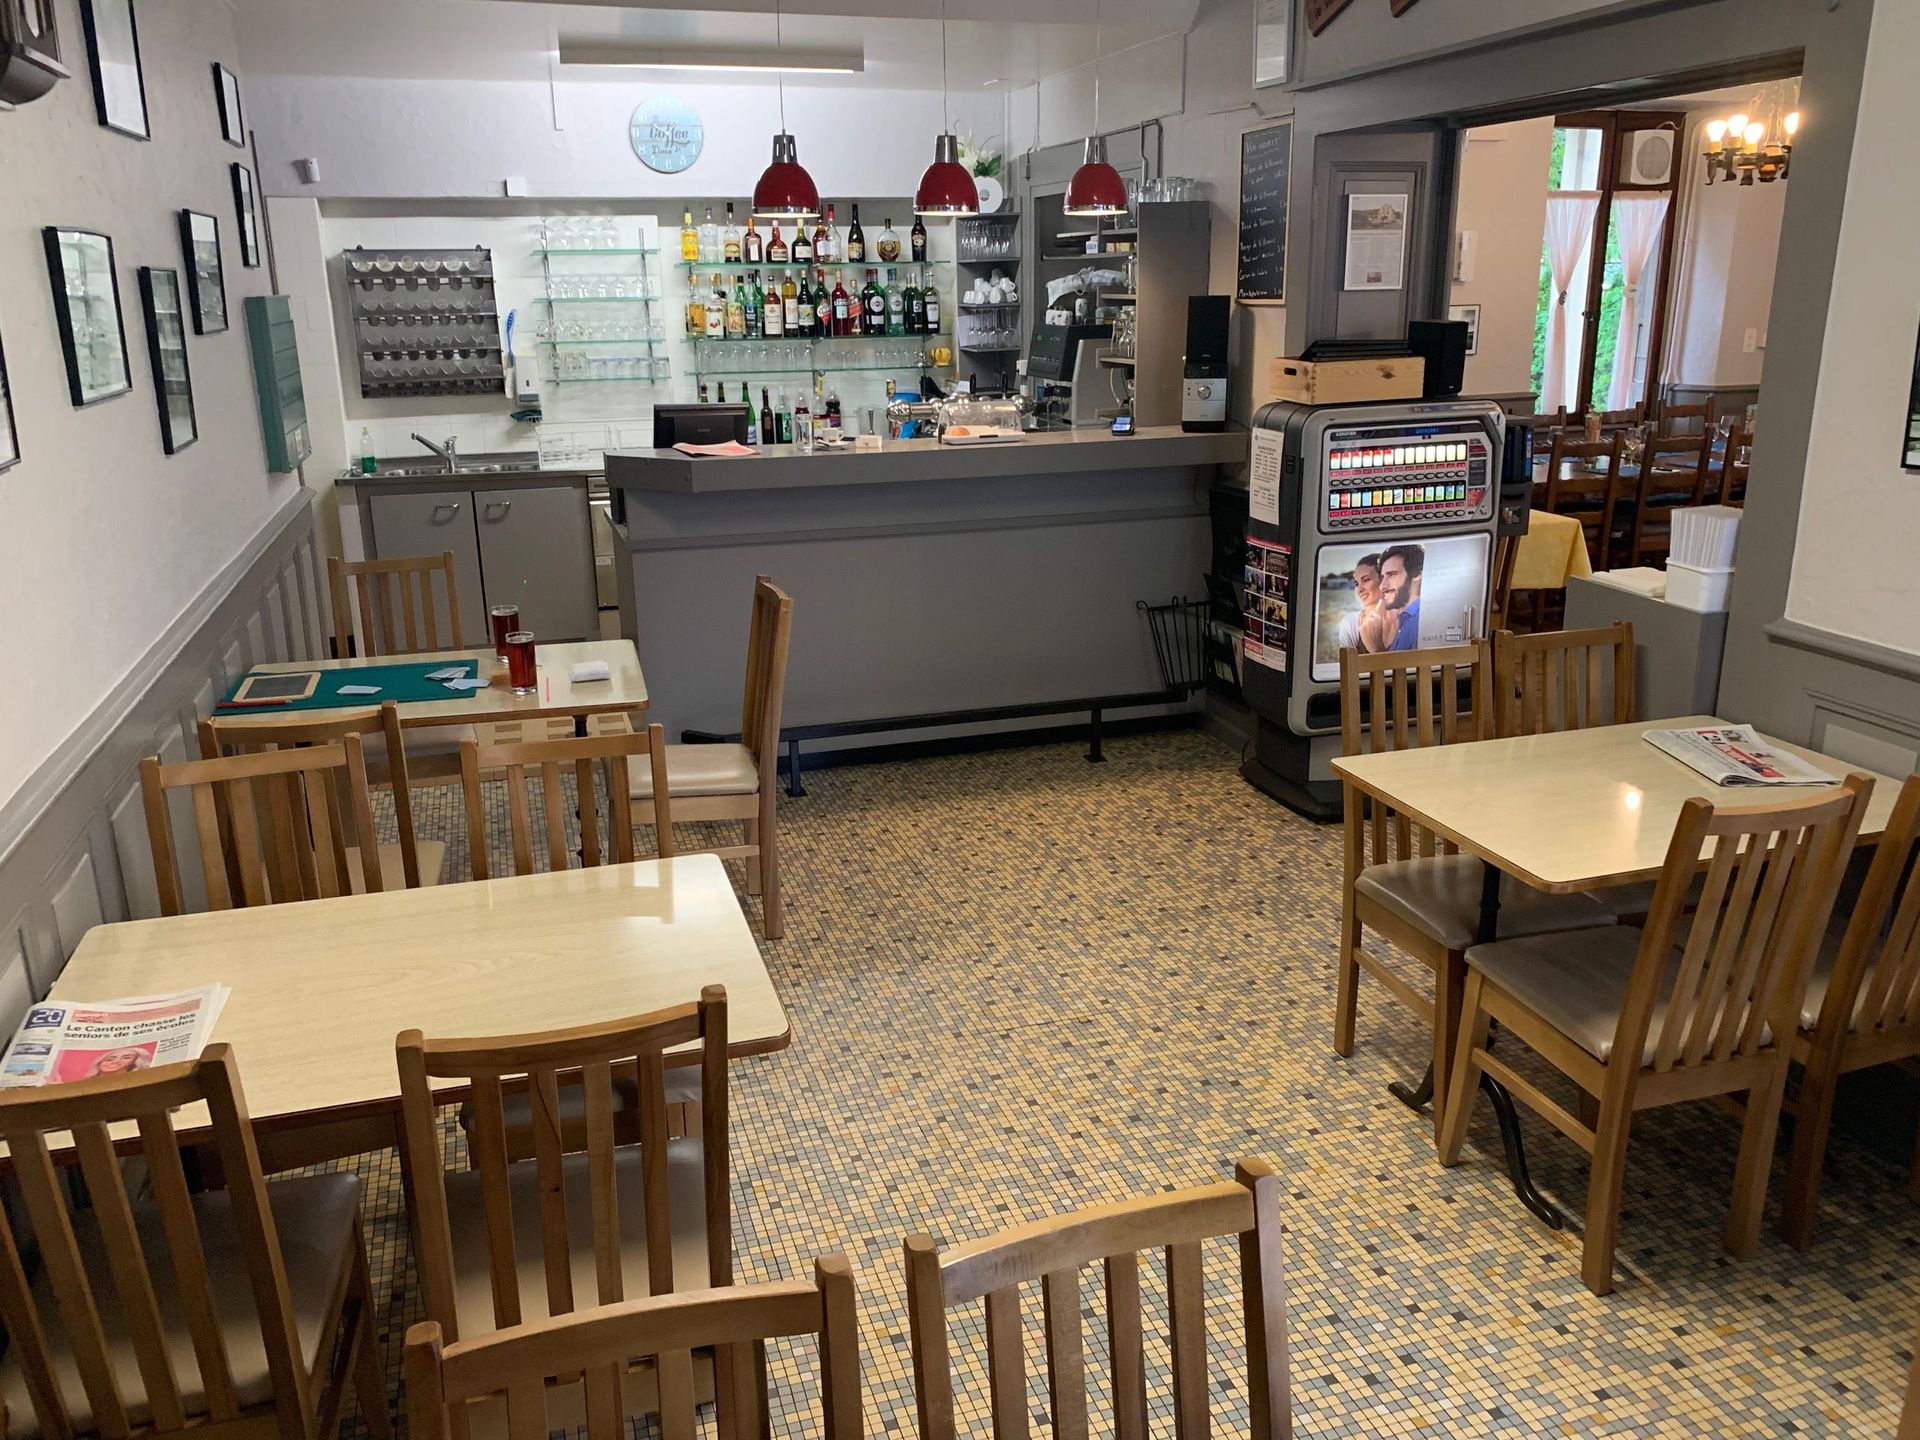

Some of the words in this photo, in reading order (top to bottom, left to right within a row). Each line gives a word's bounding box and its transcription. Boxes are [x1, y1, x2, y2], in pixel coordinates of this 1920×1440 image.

[649, 121, 689, 148] Coffee
[651, 144, 673, 155] Time
[32, 1009, 63, 1023] 20
[66, 1024, 82, 1032] Le
[133, 1018, 176, 1030] chasse
[178, 1012, 196, 1021] les
[64, 1031, 111, 1039] seniors
[132, 1028, 154, 1036] ses
[156, 1019, 195, 1031] écoles
